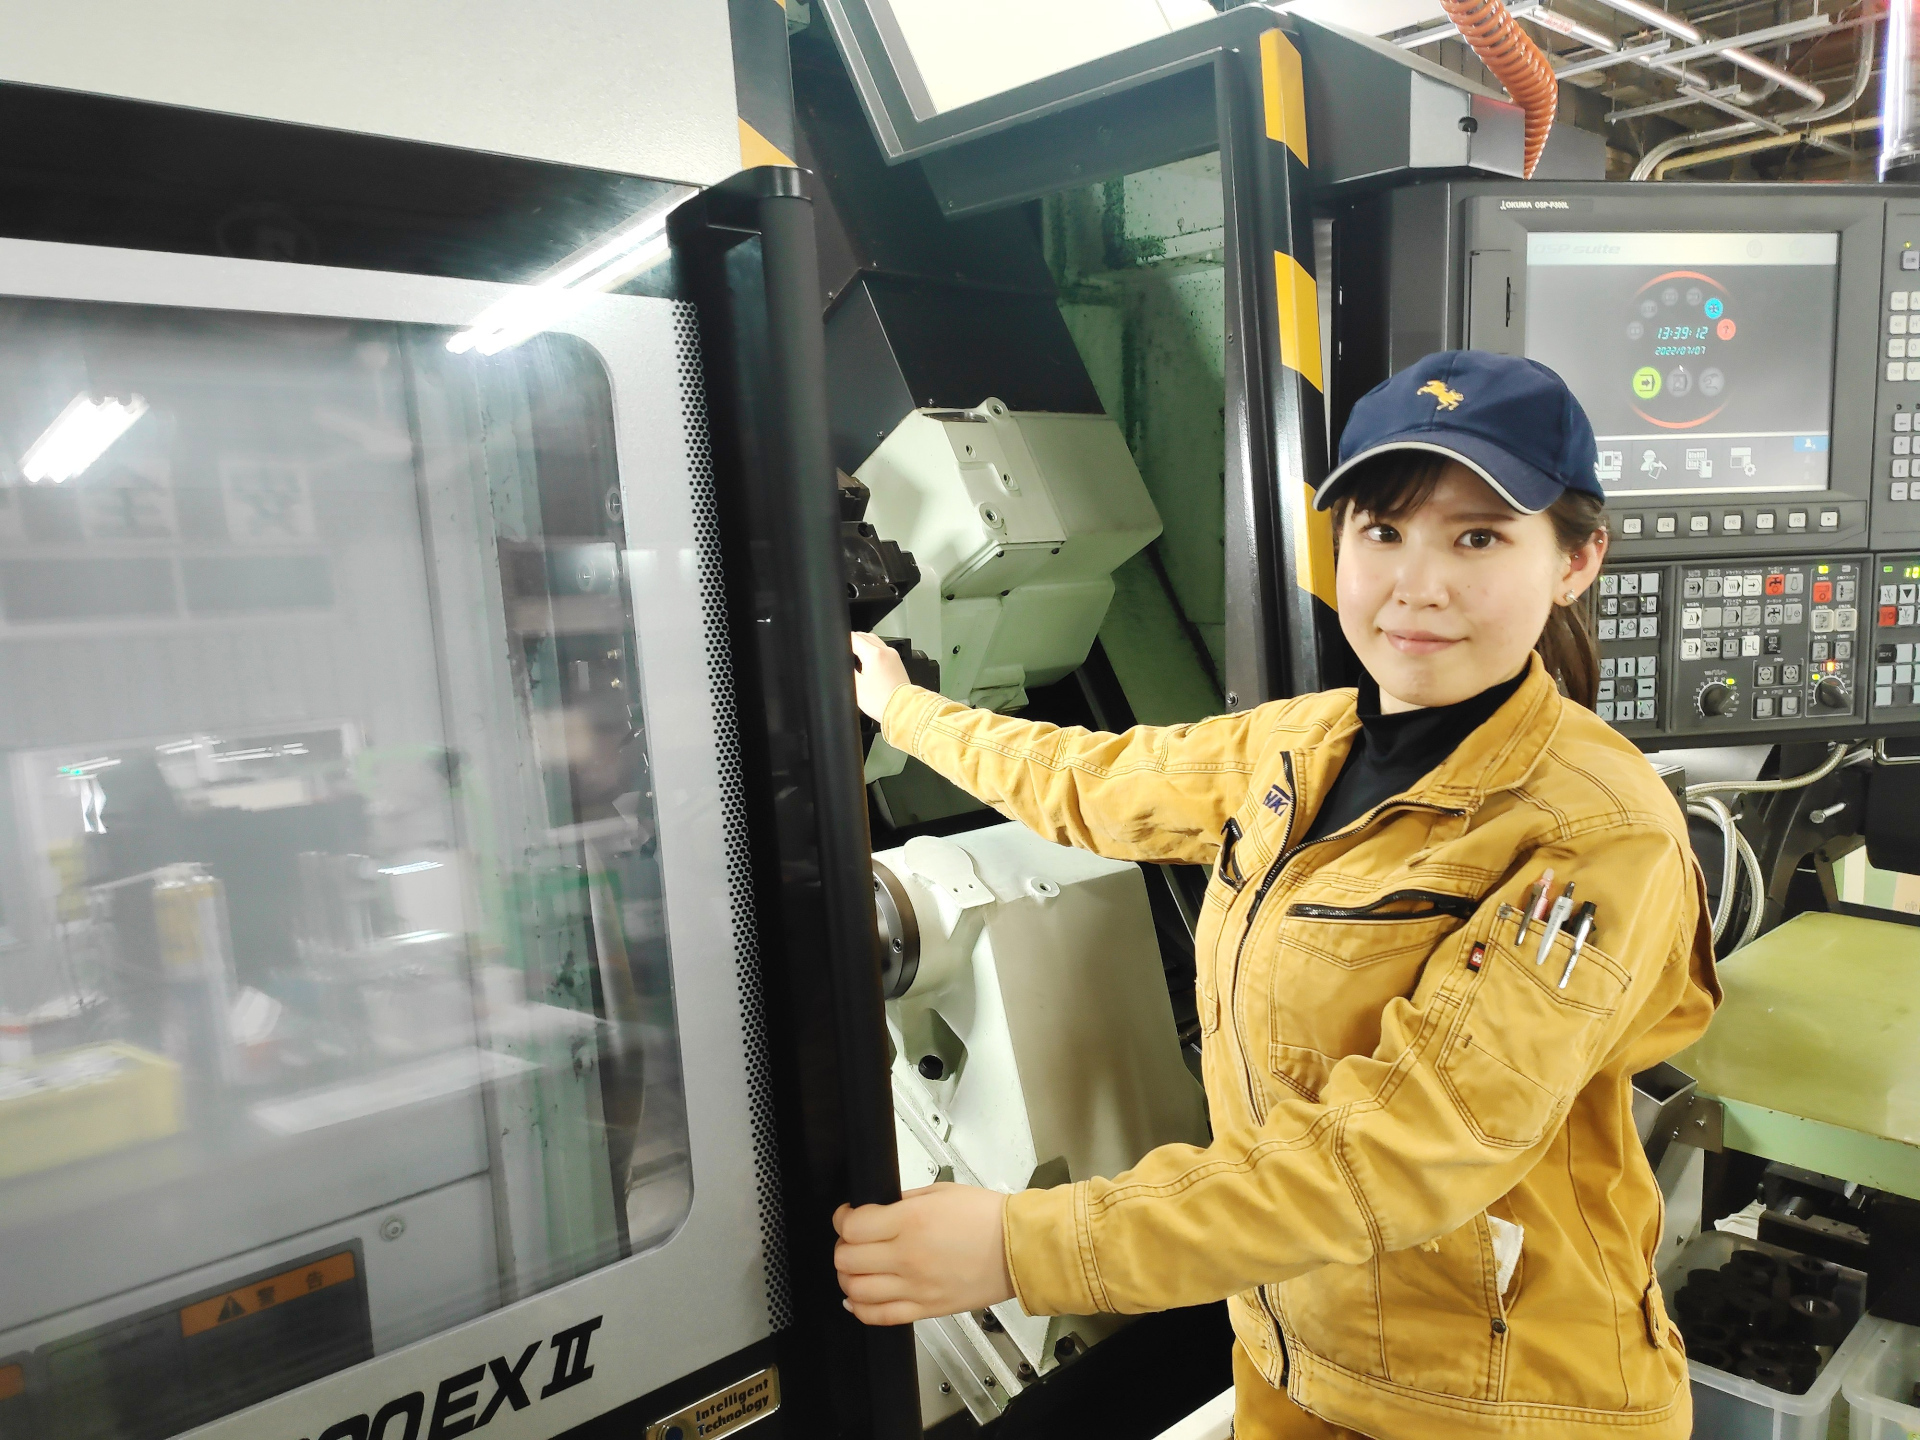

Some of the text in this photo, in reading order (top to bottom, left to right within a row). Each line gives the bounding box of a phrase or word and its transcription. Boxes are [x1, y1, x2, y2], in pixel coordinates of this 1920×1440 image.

[1505, 201, 1533, 210] OKUMA
[1572, 243, 1621, 254] suite
[1656, 326, 1709, 340] 13:39:12
[1654, 345, 1707, 356] 2022/07/07
[1761, 517, 1769, 525] F7
[1834, 662, 1844, 670] S1
[695, 1378, 769, 1422] Intelligent
[697, 1395, 769, 1437] Technology
